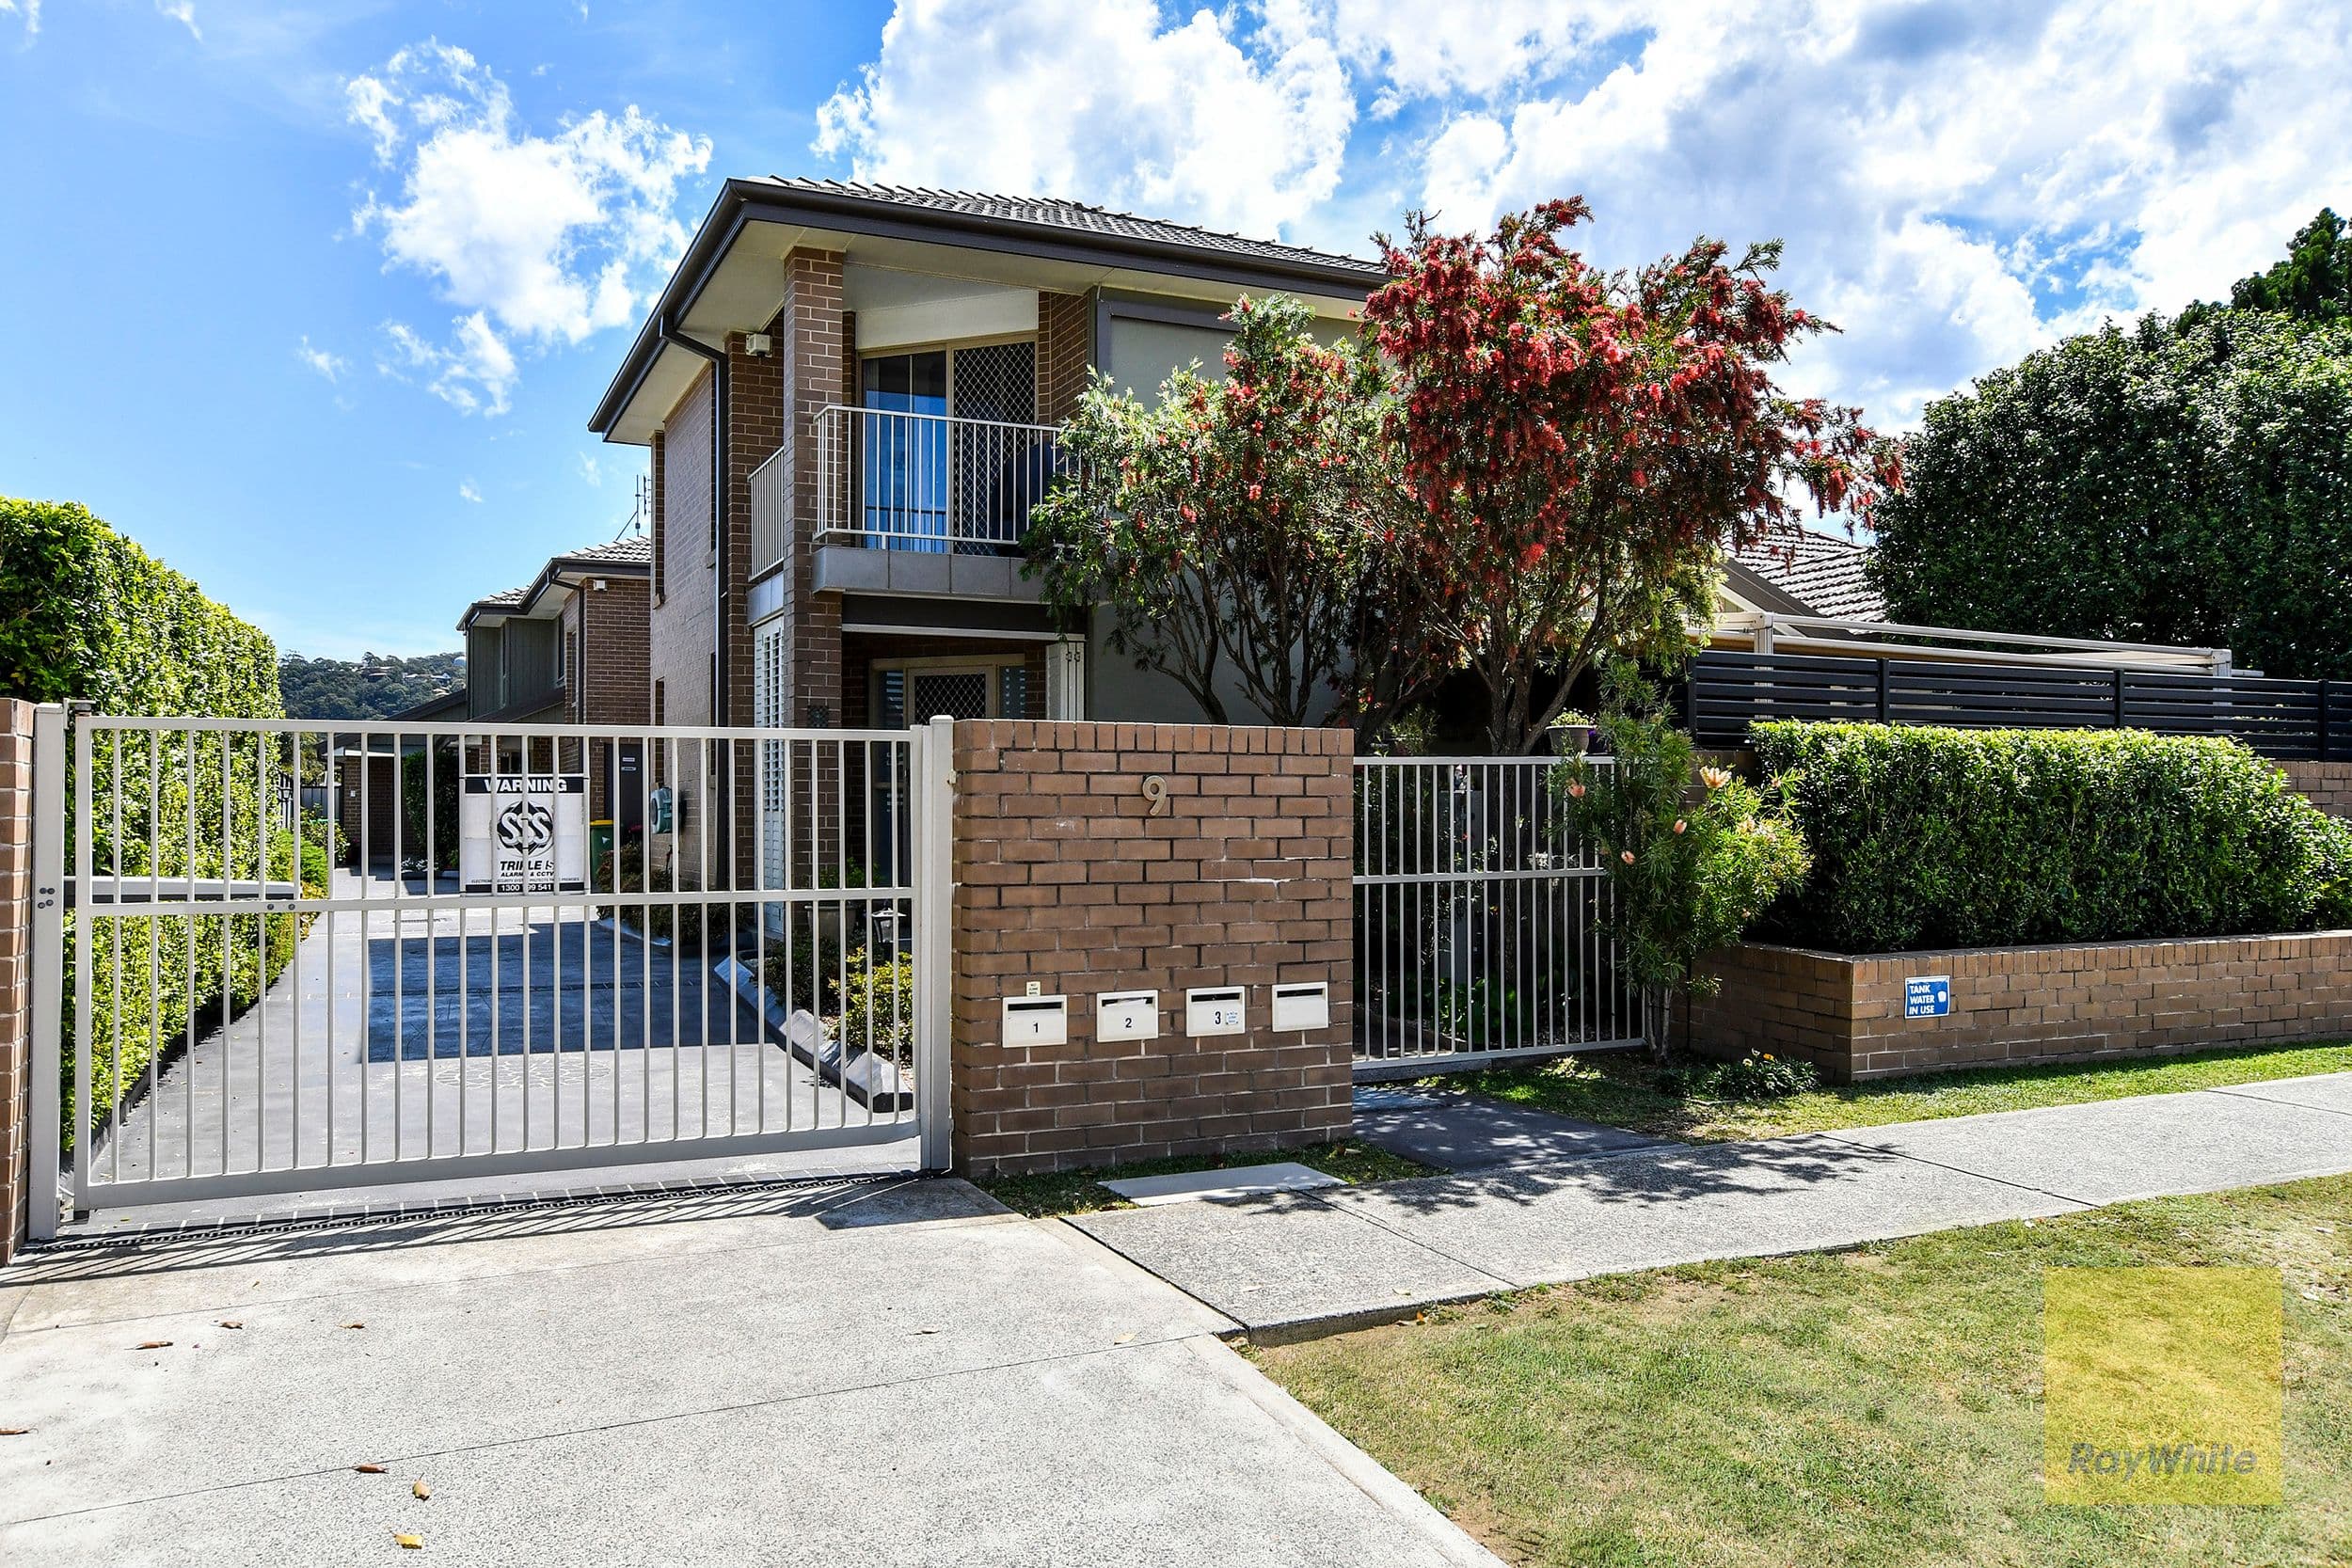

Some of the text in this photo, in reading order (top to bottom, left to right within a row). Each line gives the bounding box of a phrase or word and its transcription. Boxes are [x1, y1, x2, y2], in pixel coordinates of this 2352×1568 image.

[485, 779, 567, 791] WARNING
[1142, 775, 1167, 816] 9
[1909, 985, 1931, 994] TANK
[1909, 994, 1935, 1005] WATER
[1909, 1005, 1935, 1015] IN USE
[1125, 1017, 1132, 1028] 2
[1215, 1011, 1221, 1024] 3
[1033, 1022, 1039, 1033] 1
